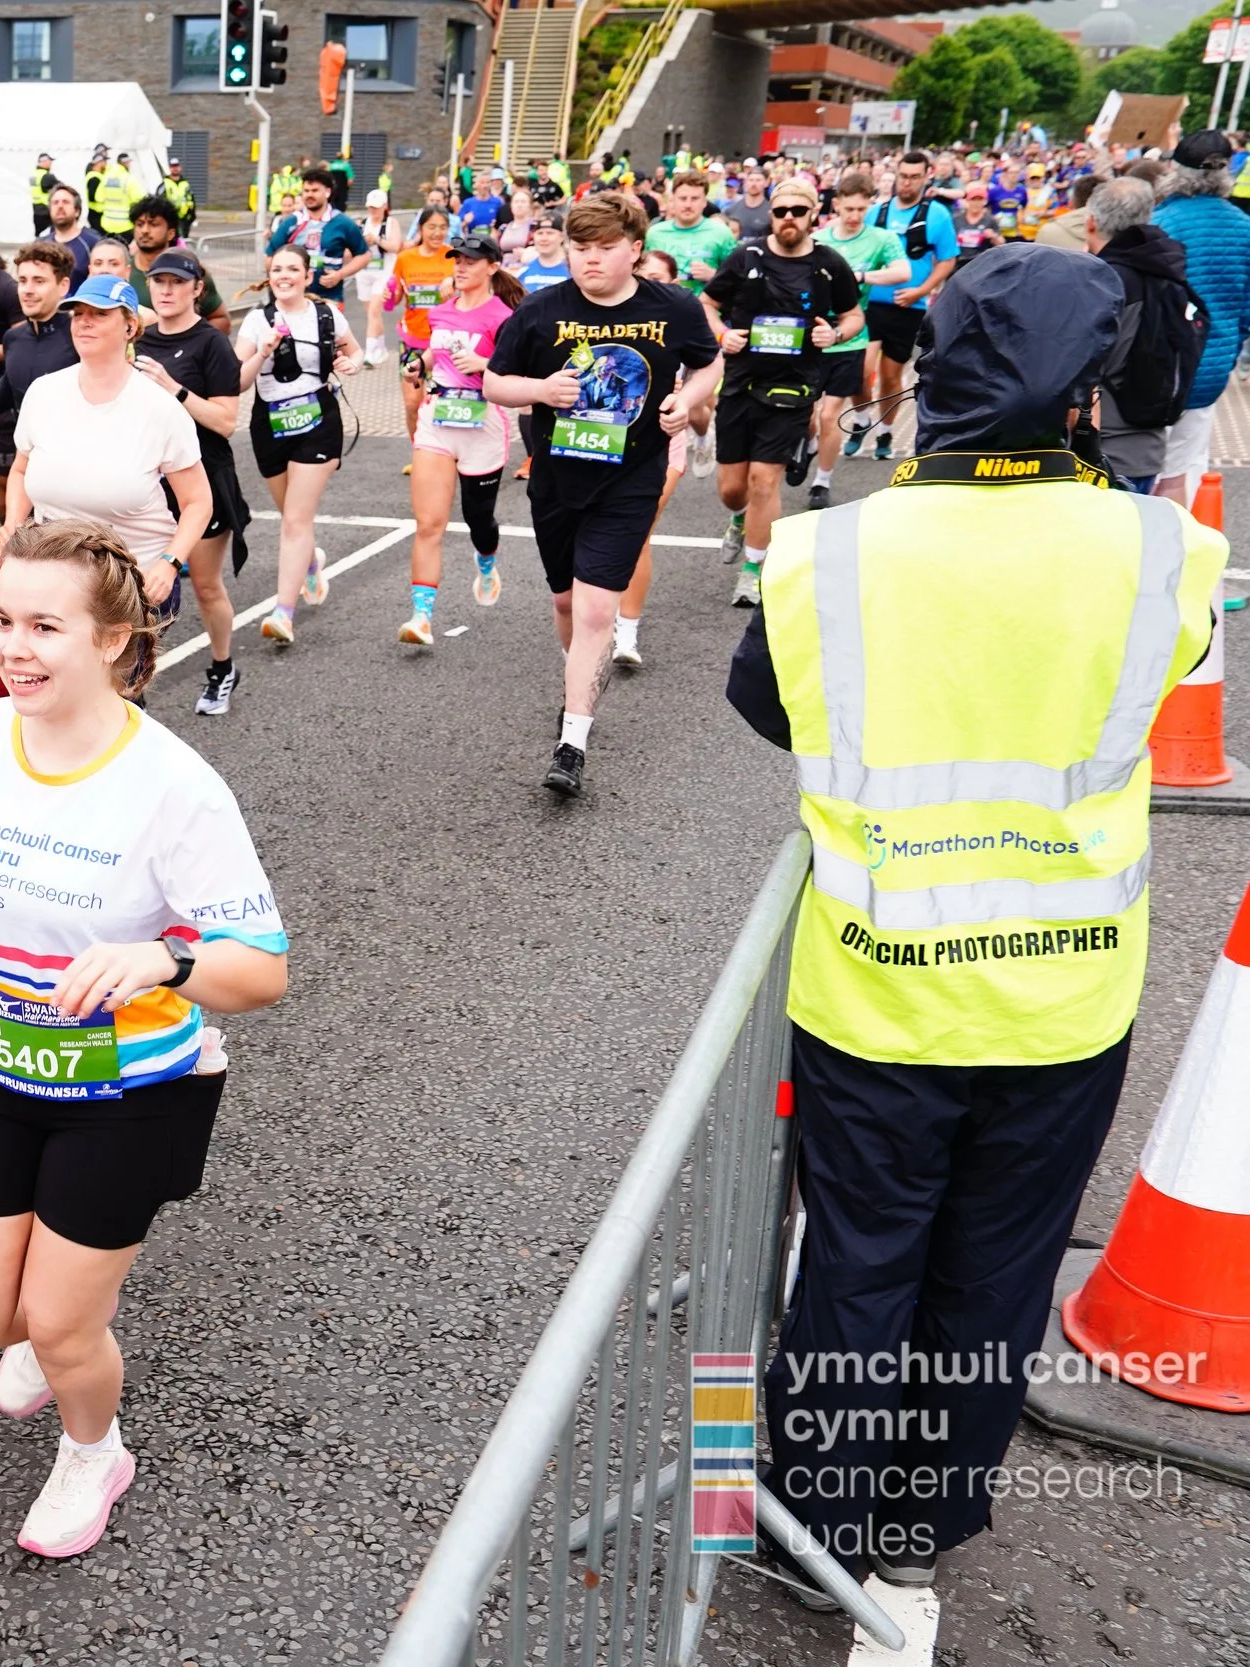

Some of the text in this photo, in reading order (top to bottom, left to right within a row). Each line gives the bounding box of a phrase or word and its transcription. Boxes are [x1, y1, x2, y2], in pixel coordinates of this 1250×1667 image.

[553, 320, 668, 347] MEGADETH
[281, 412, 312, 429] 1020
[446, 406, 472, 419] 739
[566, 431, 610, 450] 1454
[974, 458, 1041, 477] Nikon
[52, 841, 122, 866] canser
[892, 833, 994, 859] Marathon
[1000, 830, 1079, 855] Photos
[17, 879, 103, 910] research
[935, 925, 1118, 965] PHOTOGRAPHER
[24, 1002, 63, 1015] SWANS
[24, 1012, 41, 1021] Half
[87, 1032, 112, 1040] CANCER
[0, 1074, 88, 1098] #RUNSWANSEA
